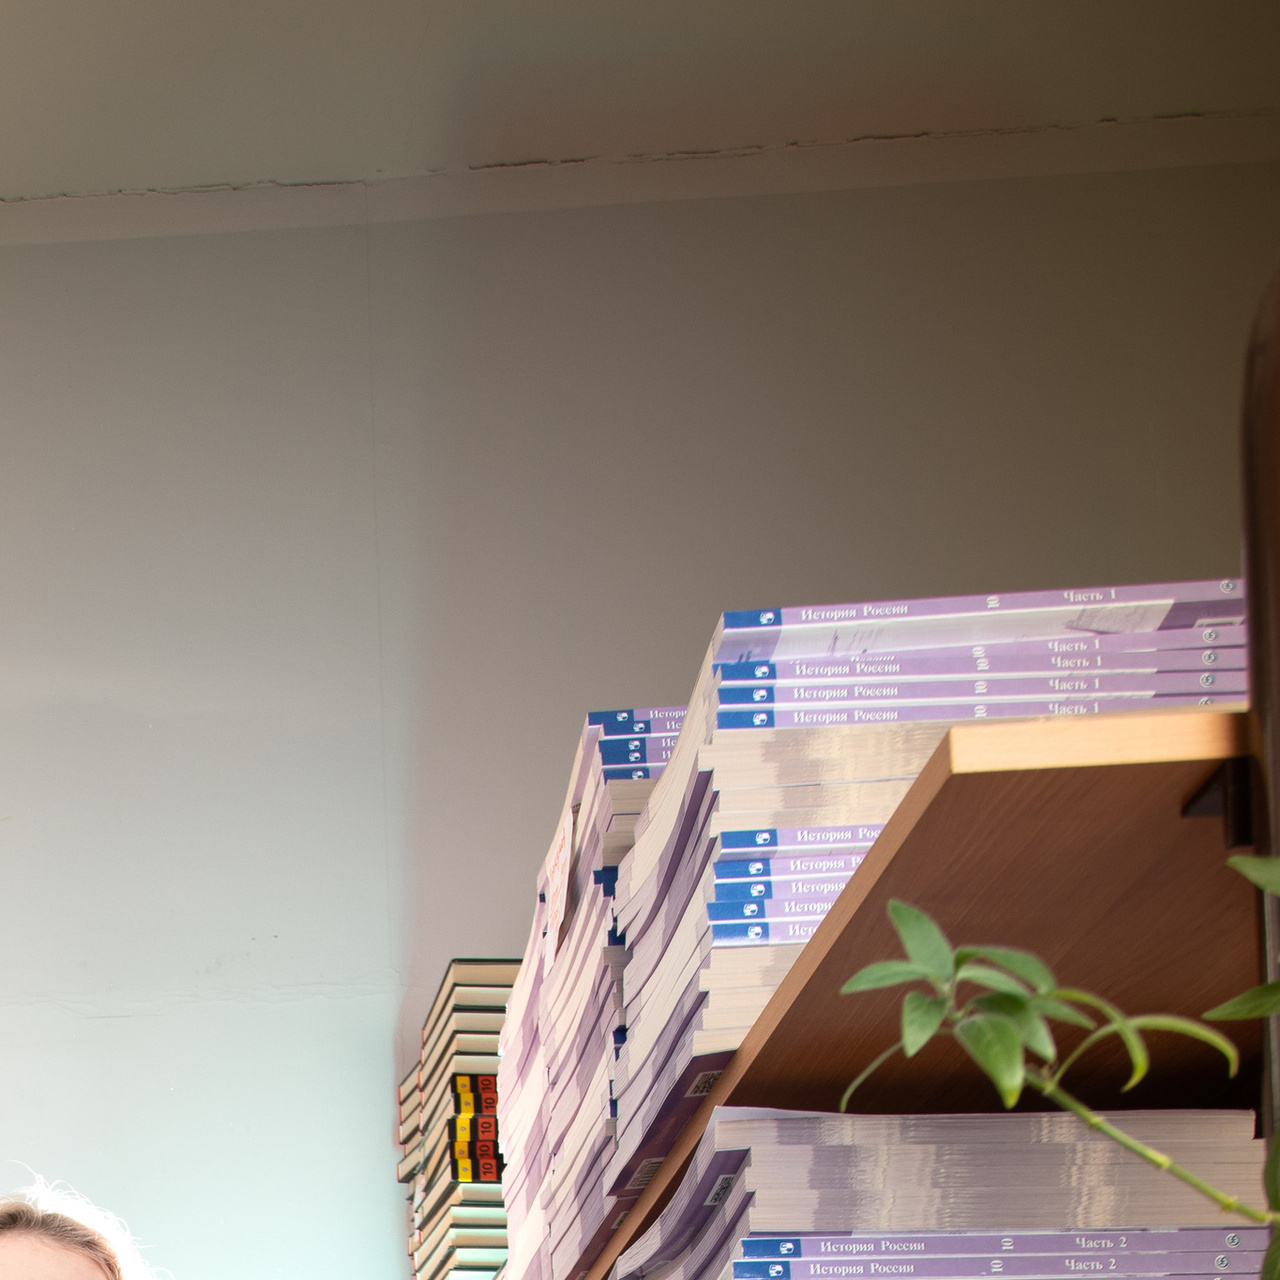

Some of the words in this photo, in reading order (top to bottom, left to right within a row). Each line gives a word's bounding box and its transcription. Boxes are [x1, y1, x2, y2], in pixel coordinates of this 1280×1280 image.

[800, 608, 856, 621] История
[863, 604, 909, 616] России
[1064, 590, 1103, 602] Часть
[793, 687, 848, 700] История
[854, 686, 898, 698] России
[1049, 678, 1087, 690] Часть
[796, 830, 852, 841] История
[790, 859, 844, 871] История
[482, 1079, 492, 1092] 10
[485, 1097, 495, 1110] 10
[481, 1121, 492, 1134] 10
[480, 1144, 491, 1157] 10
[483, 1162, 493, 1175] 10
[820, 1241, 875, 1253] История
[881, 1240, 925, 1251] России
[1002, 1238, 1013, 1250] 10
[1076, 1237, 1113, 1249] Часть
[1119, 1237, 1127, 1247] 2
[809, 1263, 864, 1276] История
[870, 1263, 915, 1273] России
[991, 1260, 1003, 1272] 10
[1065, 1259, 1103, 1271] Часть
[1109, 1259, 1117, 1269] 2
